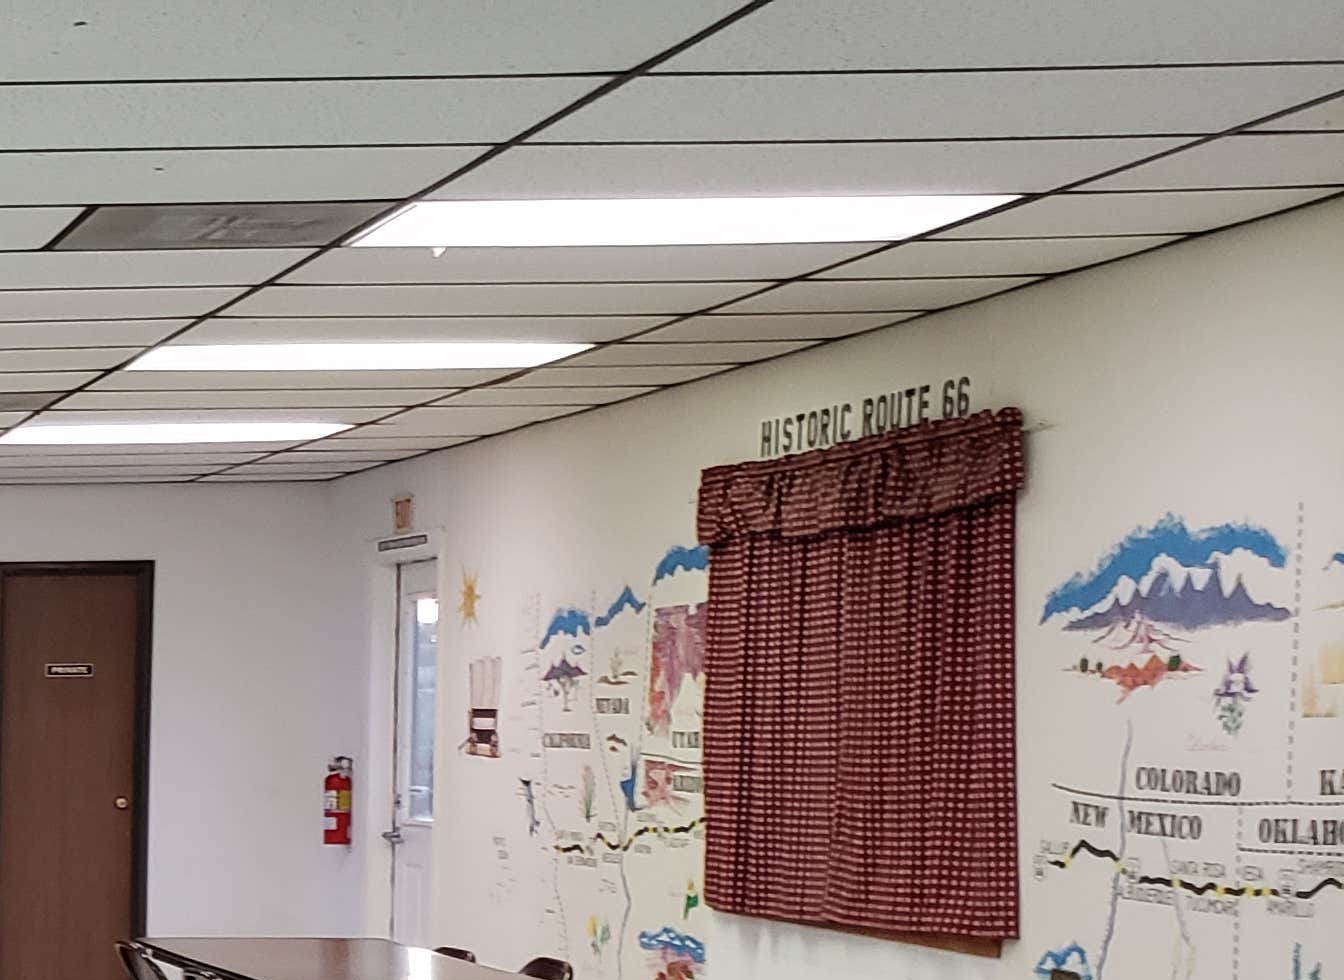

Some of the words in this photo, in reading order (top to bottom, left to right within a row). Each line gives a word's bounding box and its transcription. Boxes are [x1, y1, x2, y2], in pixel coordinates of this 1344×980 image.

[759, 402, 853, 458] HISTORIC
[862, 384, 931, 437] ROUTE
[942, 376, 971, 419] 66
[1135, 766, 1242, 797] COLORADO
[1069, 800, 1110, 829] NEW
[1126, 809, 1203, 841] MEXICO
